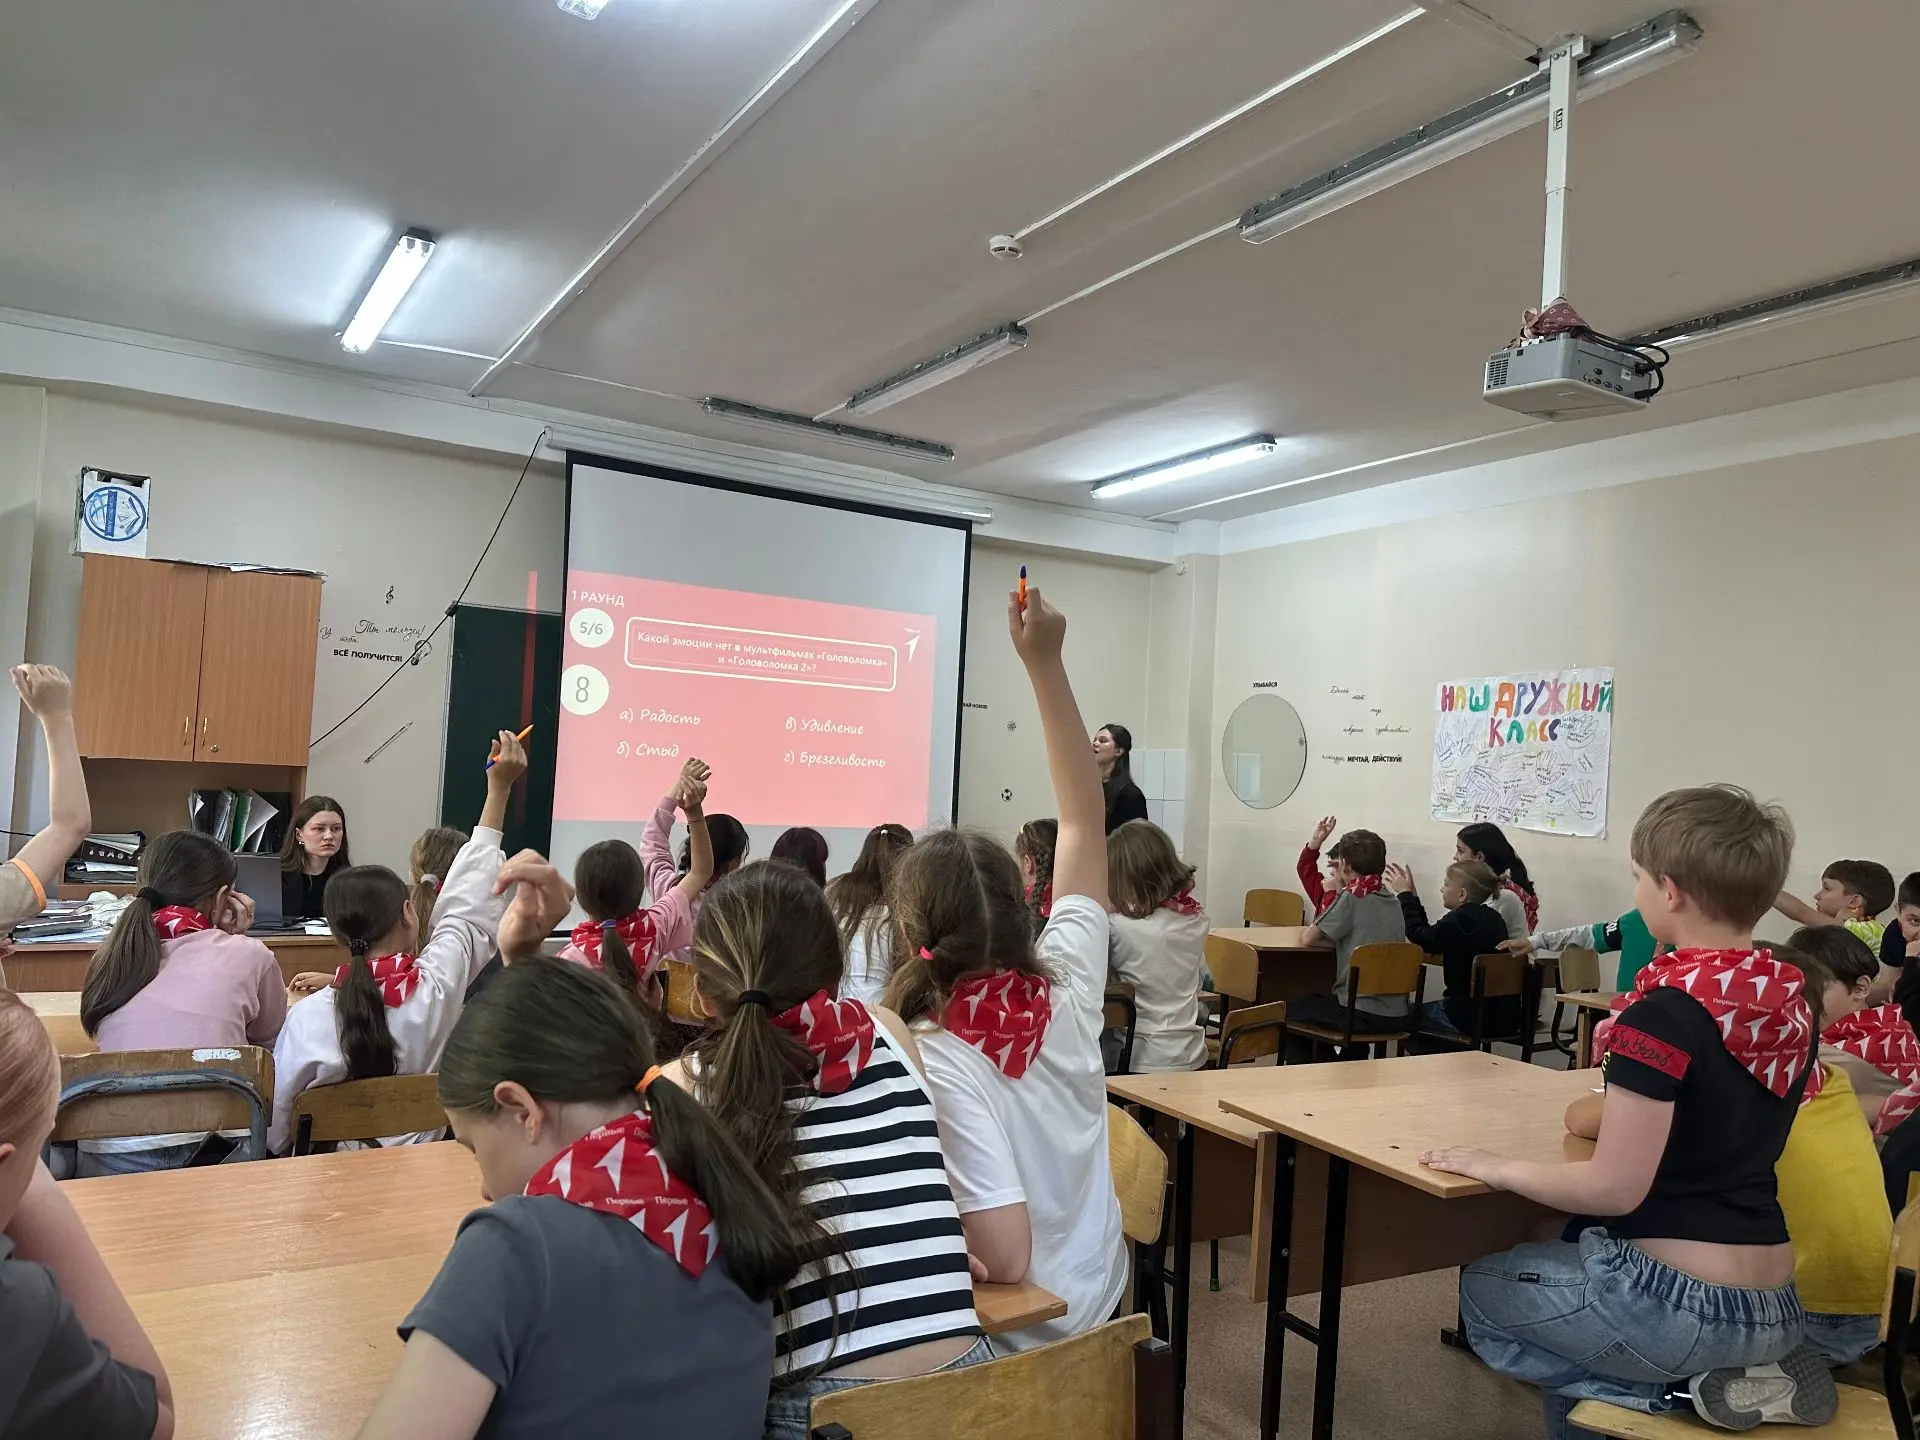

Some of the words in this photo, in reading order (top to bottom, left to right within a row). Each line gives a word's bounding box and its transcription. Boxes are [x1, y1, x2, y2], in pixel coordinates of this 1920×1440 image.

[571, 590, 577, 601] 1
[580, 591, 625, 608] РАУНД
[355, 619, 380, 634] Ты
[580, 622, 603, 636] 5/6
[333, 648, 349, 657] ВСЁ
[351, 651, 403, 662] ПОЛУЧИТСЯ!
[637, 631, 669, 644] Какой
[672, 637, 712, 650] эмоции
[715, 642, 732, 651] нет
[744, 645, 814, 660] мультфильмах
[817, 651, 887, 667] «Головоломка»
[728, 656, 799, 671] «Головоломка
[800, 662, 817, 673] 2»?
[576, 676, 589, 703] 8
[1441, 683, 1490, 712] НАШ
[1494, 679, 1611, 718] ДРУЖНЫЙ
[619, 707, 634, 723] а)
[640, 708, 701, 725] Радость
[785, 716, 797, 733] в)
[800, 718, 864, 735] Удивление
[1489, 717, 1562, 748] КЛАСС
[616, 740, 630, 758] б)
[636, 743, 680, 758] Стыд
[800, 751, 886, 768] Брезгливость
[1712, 997, 1740, 1007] Первые
[605, 1196, 645, 1206] Первые
[654, 1196, 688, 1206] Первые
